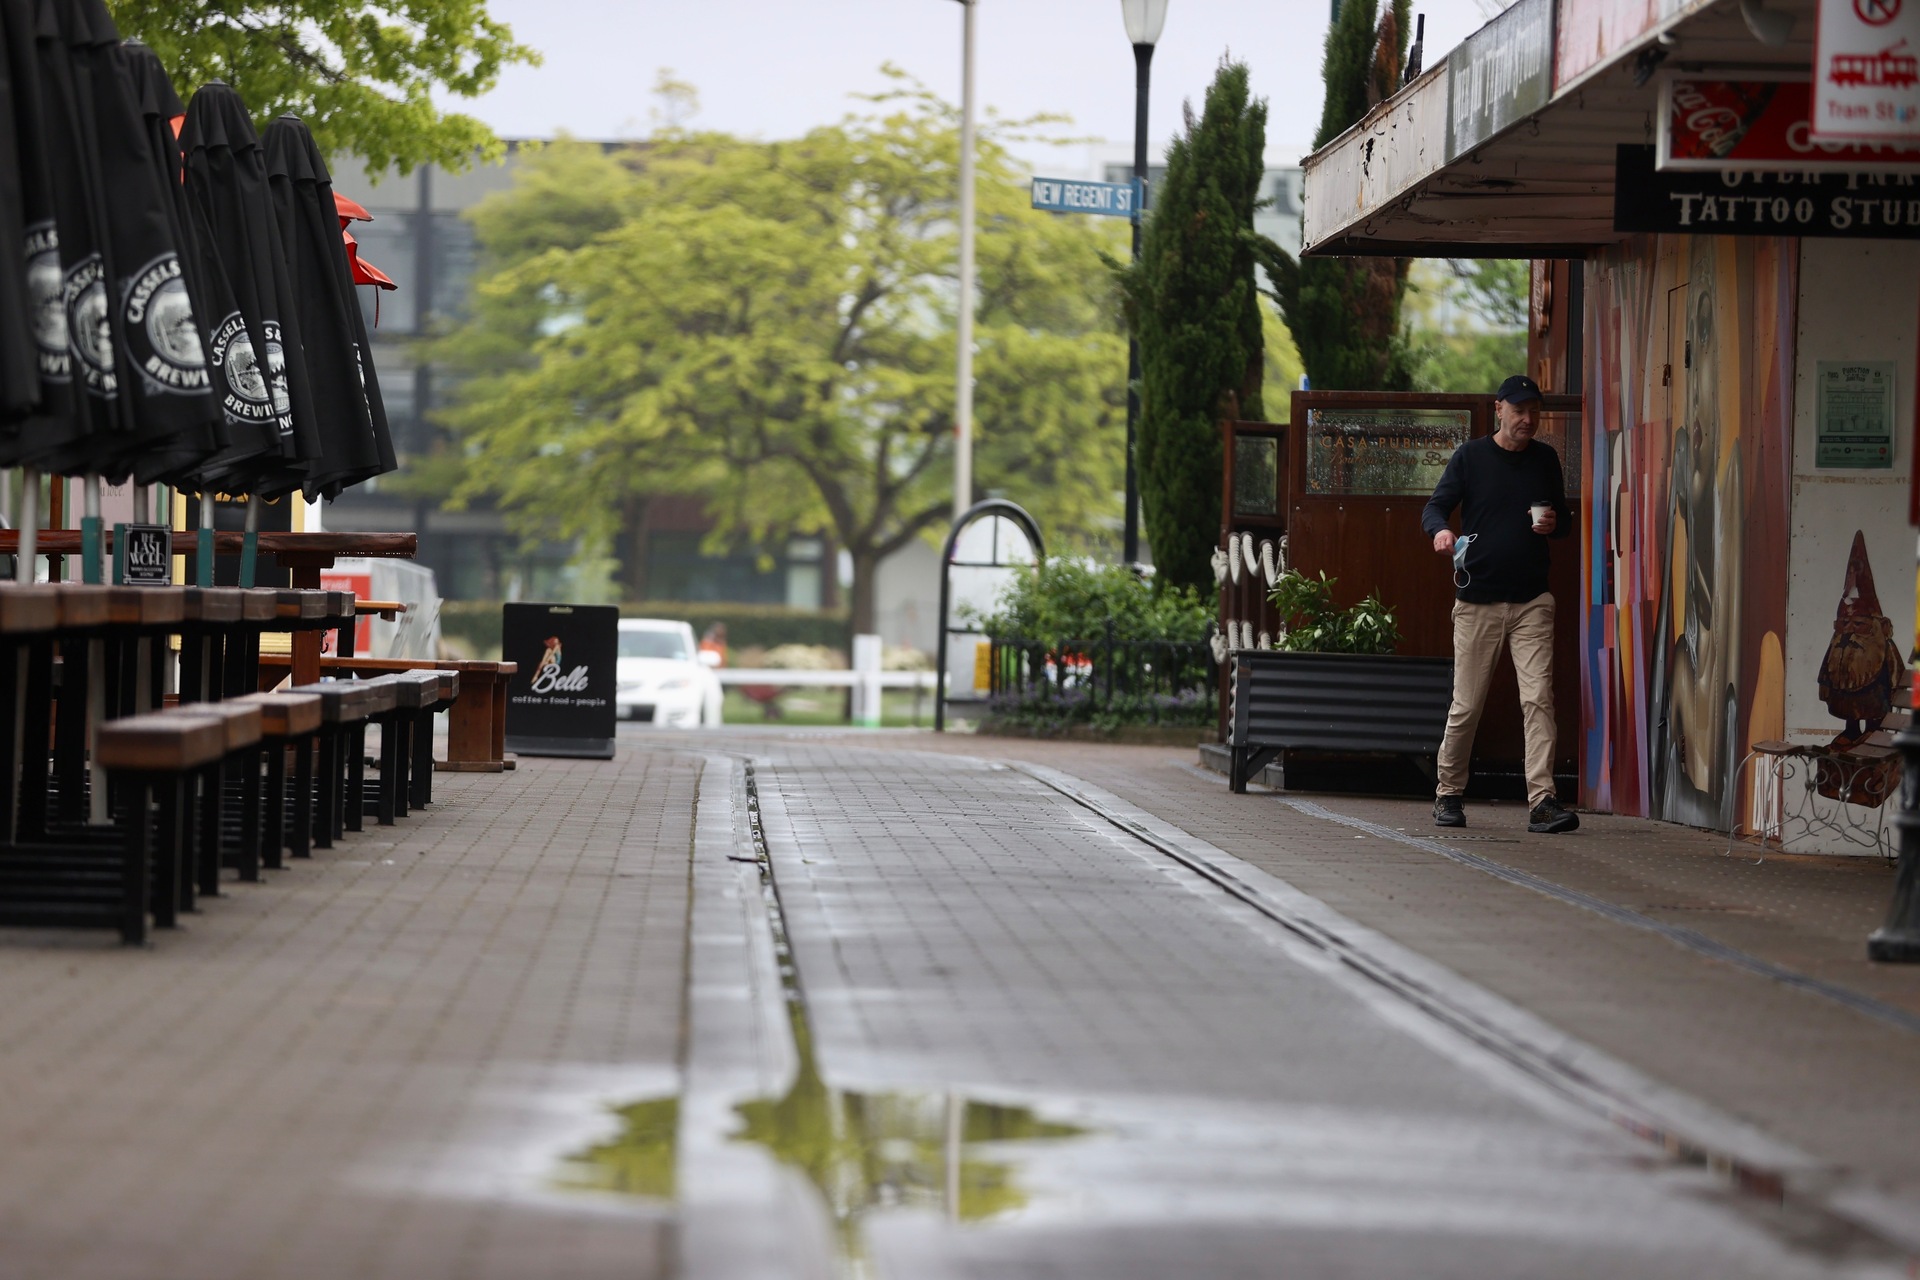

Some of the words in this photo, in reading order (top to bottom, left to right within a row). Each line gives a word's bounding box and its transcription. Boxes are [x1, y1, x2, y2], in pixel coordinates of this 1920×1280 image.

[1828, 99, 1870, 120] Tram
[1875, 100, 1918, 124] Stp
[1033, 180, 1062, 206] NEW
[1063, 182, 1114, 209] REGENT
[1115, 187, 1134, 212] ST
[1669, 192, 1815, 226] TATTOO
[126, 258, 182, 324] CASSELS
[1320, 435, 1368, 449] CASA
[1377, 436, 1456, 451] PUBLICA
[1421, 450, 1450, 467] Ba
[134, 541, 162, 554] LAST
[129, 552, 167, 566] WORD
[531, 663, 589, 694] Belle
[512, 695, 542, 705] coffee
[549, 695, 570, 705] food
[576, 697, 607, 707] people
